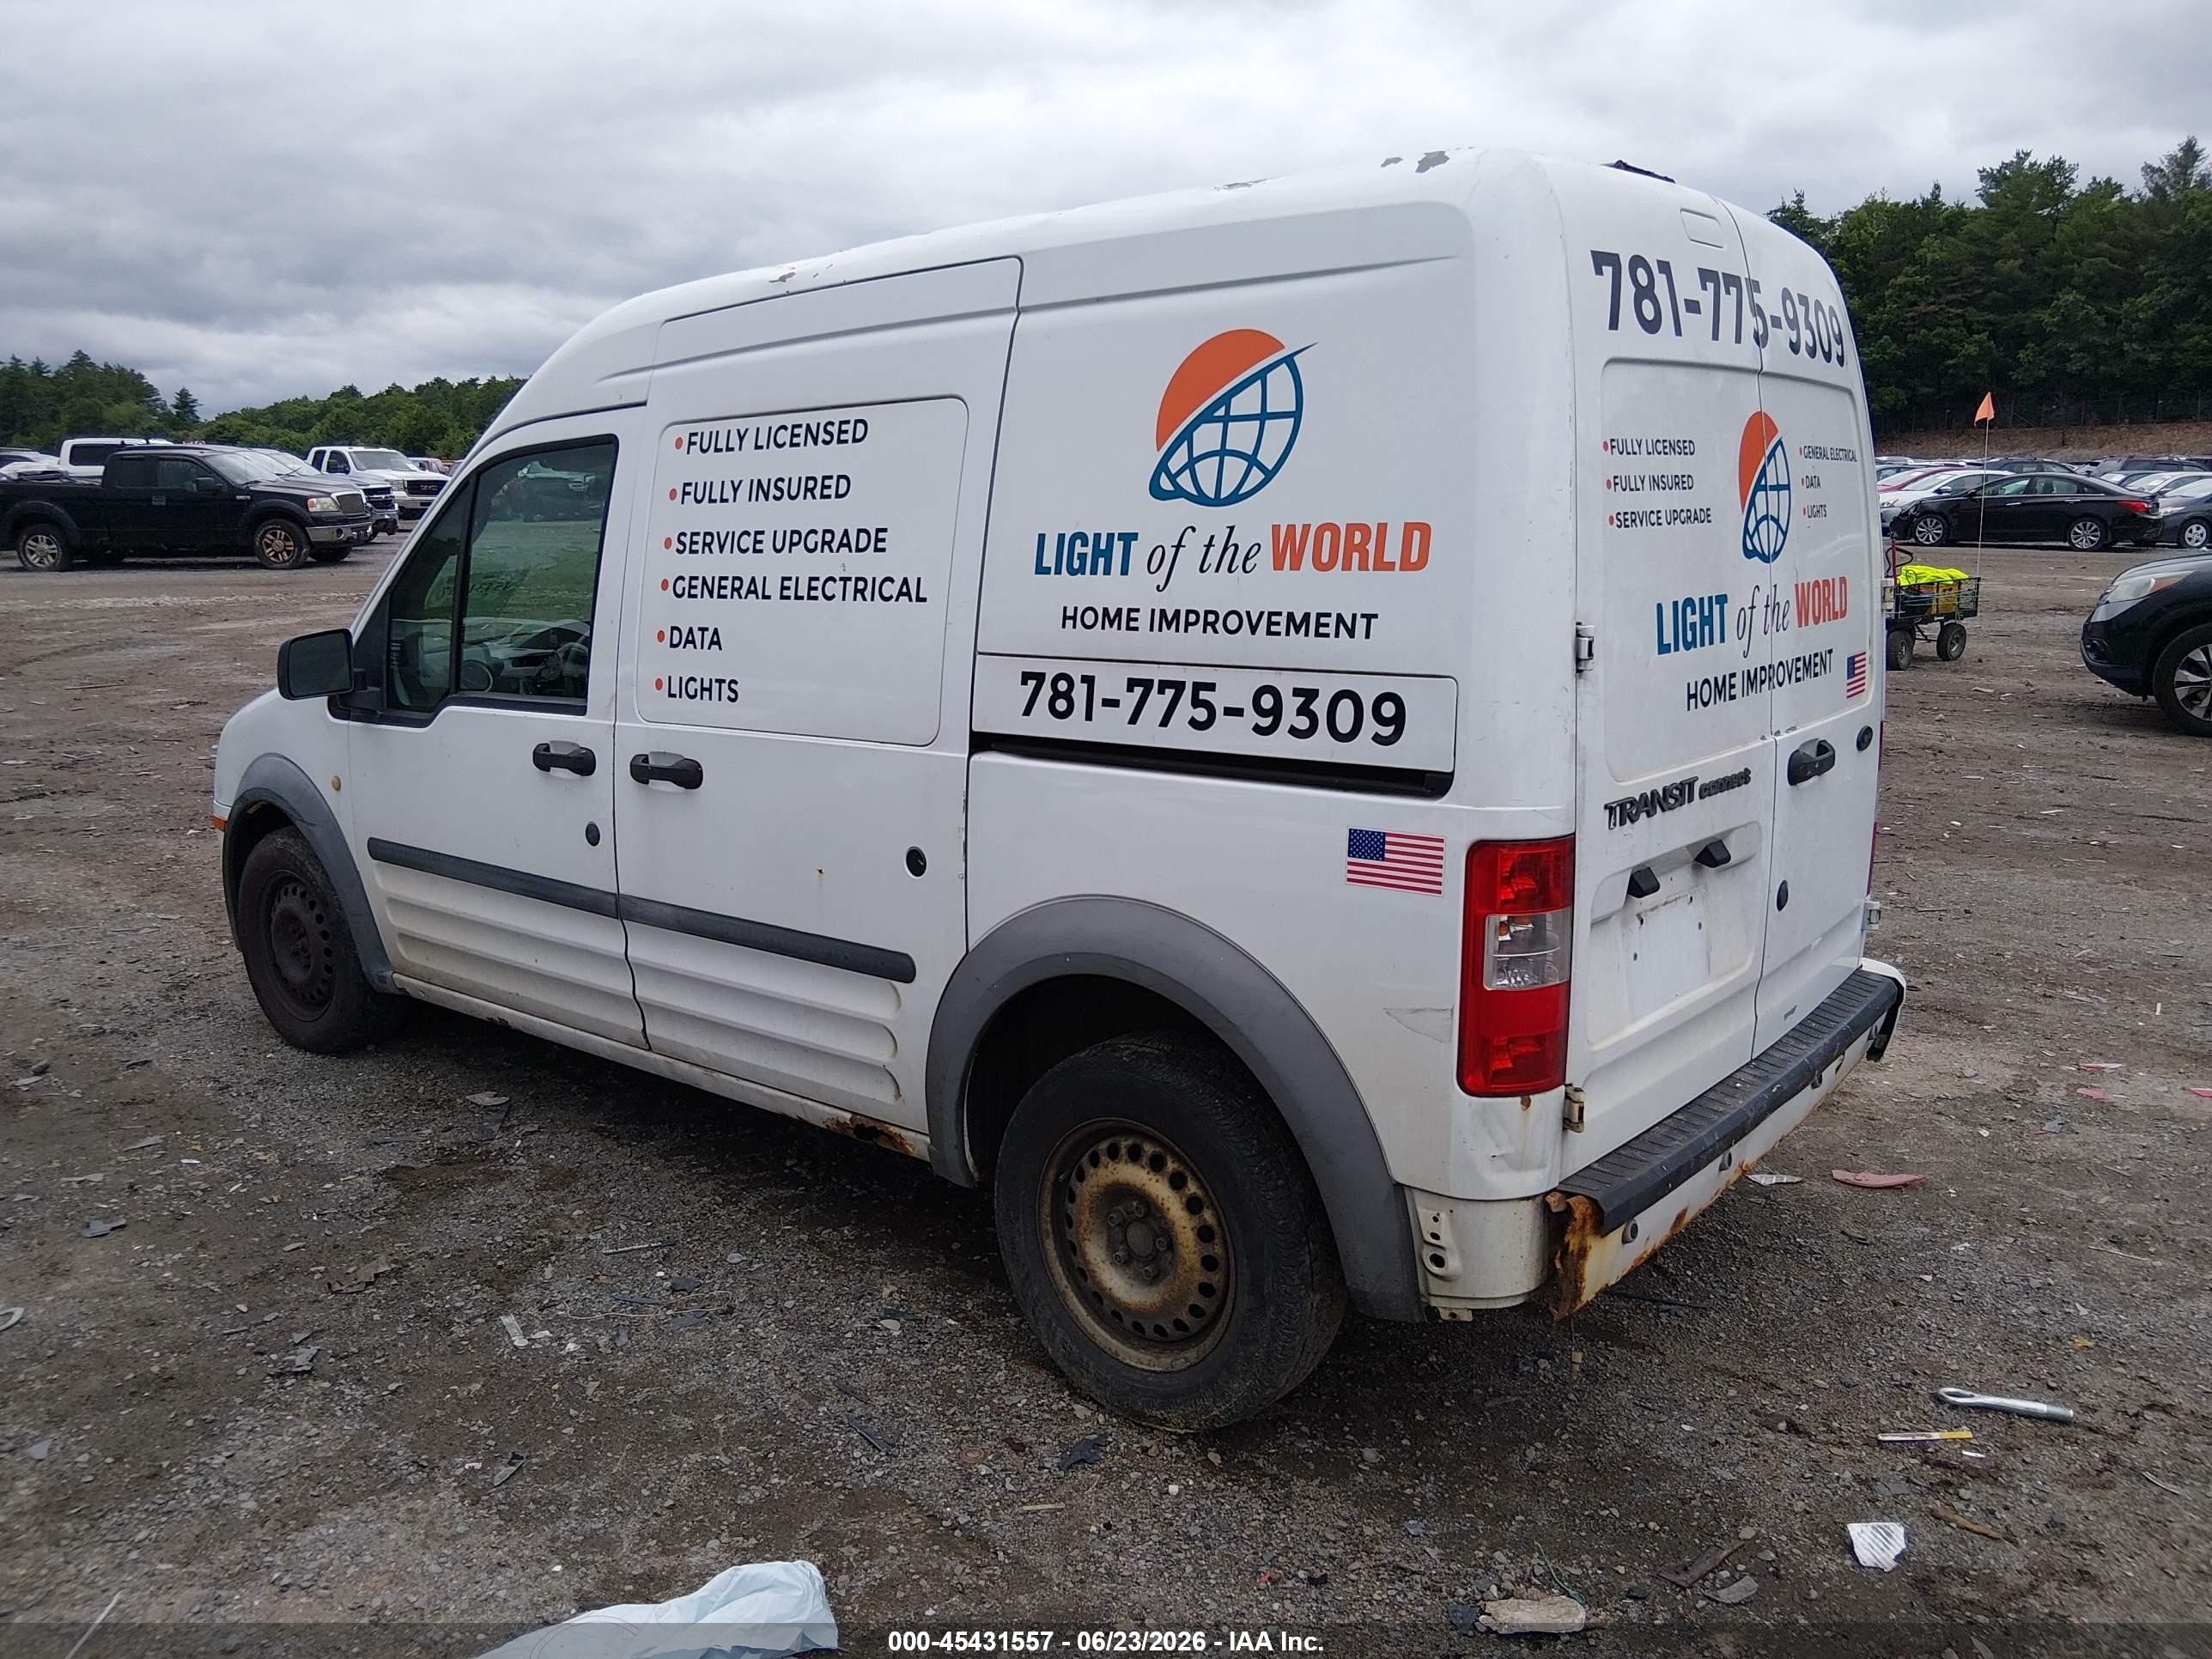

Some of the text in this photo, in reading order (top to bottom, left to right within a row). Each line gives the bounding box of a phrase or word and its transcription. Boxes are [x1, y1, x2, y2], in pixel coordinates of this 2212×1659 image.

[1589, 248, 1845, 368] 781-775-9309
[686, 418, 869, 455] FULLY LICENSED
[1609, 439, 1696, 456] FULLY LICENSED
[1803, 445, 1857, 462] GENERAL ELECTRICAL
[681, 474, 852, 505] FULLY INSURED
[1613, 474, 1694, 492] FULLY INSURED
[1805, 475, 1821, 489] DATA
[1614, 507, 1712, 529] SERVICE UPGRADE
[1807, 504, 1827, 519] LIGHTS
[675, 527, 889, 555] SERVICE UPGRADE
[1034, 521, 1432, 592] LIGHT of the WORLD
[672, 575, 928, 603] GENERAL ELECTRICAL
[1061, 606, 1379, 640] HOME IMPROVEMENT
[1656, 576, 1848, 659] LIGHT of the WORLD
[669, 625, 723, 651] DATA
[666, 676, 739, 703] LIGHTS
[1686, 648, 1834, 712] HOME IMPROVEMENT
[1019, 670, 1407, 747] 781-775-9309
[1603, 776, 1699, 830] TRANSIT
